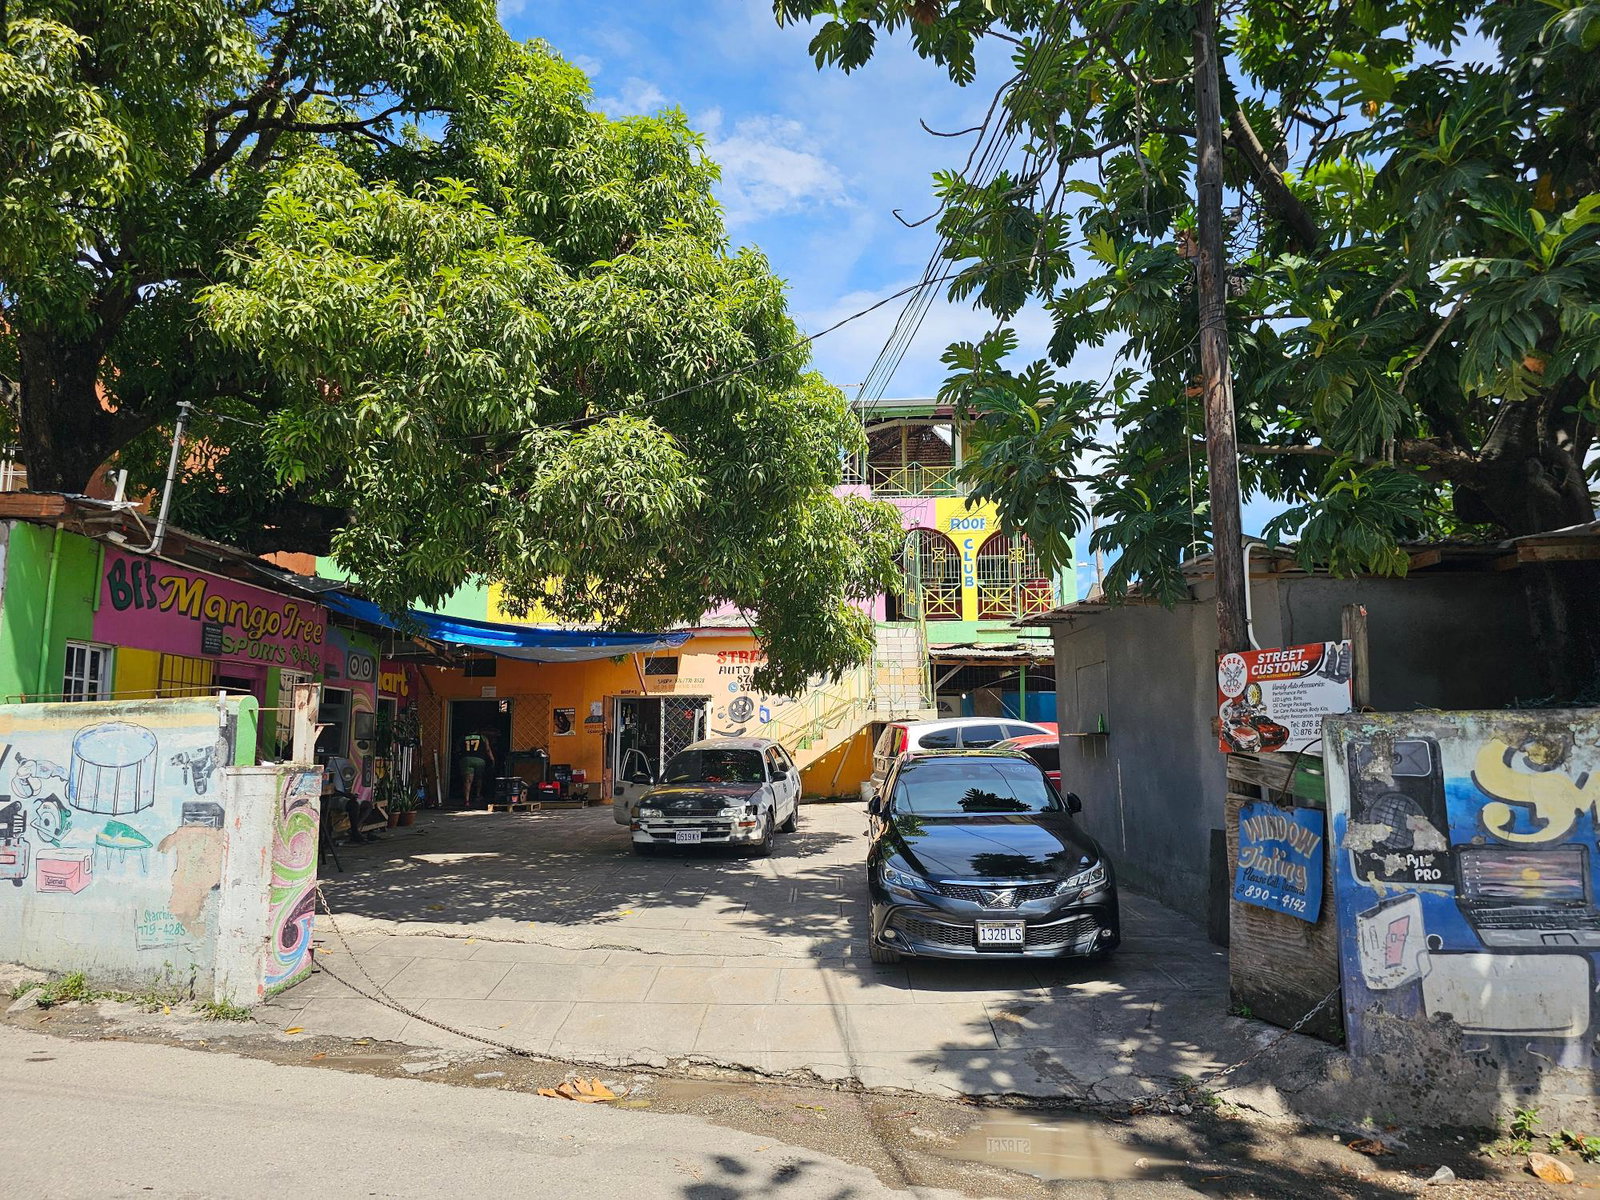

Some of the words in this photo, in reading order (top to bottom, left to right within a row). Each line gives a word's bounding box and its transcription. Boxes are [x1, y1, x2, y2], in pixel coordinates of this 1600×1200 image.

[950, 518, 985, 530] ROOF
[963, 538, 974, 587] CLUB
[158, 575, 281, 640] Mango
[282, 602, 324, 644] Tree
[221, 635, 287, 663] SPORTS
[290, 644, 320, 672] BAR
[716, 650, 767, 664] STRE
[1258, 649, 1305, 664] STREET
[718, 666, 750, 674] AUTO
[1219, 657, 1246, 672] STREET
[1251, 660, 1309, 676] CUSTOMS
[1302, 720, 1314, 728] 876
[1300, 728, 1312, 736] 876
[466, 740, 480, 752] 17
[1242, 816, 1321, 858] WINDOW
[1238, 846, 1307, 890] Tinting
[1414, 868, 1442, 881] PRO
[1243, 867, 1266, 885] Please
[982, 928, 1022, 940] 1328LS
